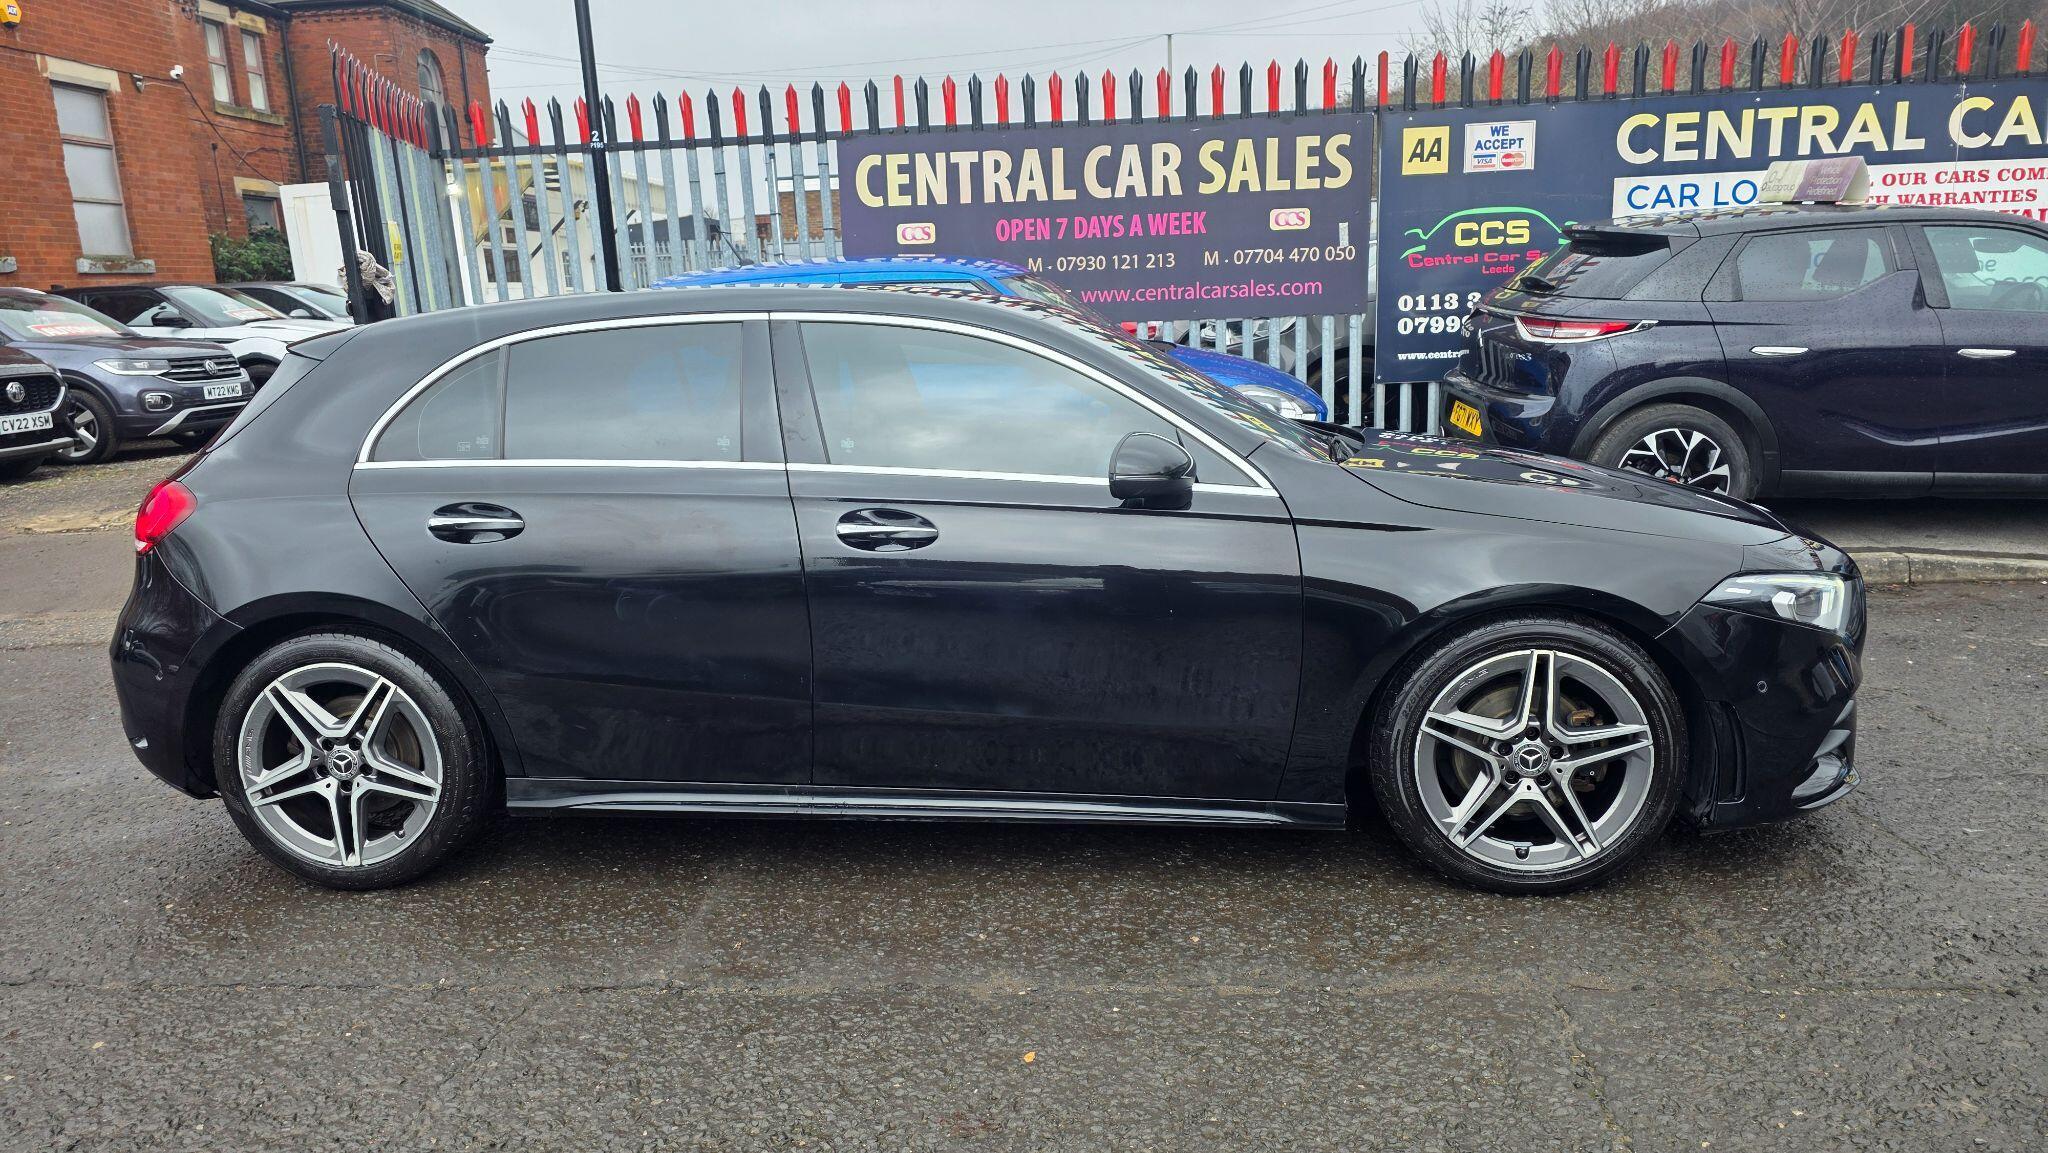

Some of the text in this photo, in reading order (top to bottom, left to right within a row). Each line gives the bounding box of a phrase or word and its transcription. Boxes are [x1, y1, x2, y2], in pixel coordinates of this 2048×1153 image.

[591, 130, 600, 142] 2
[1490, 125, 1510, 137] WE
[1616, 95, 2048, 165] CENTRAL CA
[1408, 137, 1442, 163] AA
[1474, 138, 1524, 151] ACCEPT
[855, 133, 1353, 208] CENTRAL CAR SALES
[1882, 172, 1928, 187] OUR
[1934, 169, 1990, 184] CARS
[1997, 166, 2048, 182] COM
[1627, 179, 1758, 210] CAR LO
[1897, 188, 2038, 205] WARRANTIES
[995, 211, 1207, 242] OPEN 7 DAYS A WEEK
[1274, 211, 1306, 227] CCS
[901, 225, 932, 242] CCS
[1454, 219, 1530, 247] CCS
[1028, 257, 1043, 273] M
[1056, 256, 1106, 272] 07930
[1112, 254, 1139, 270] 121
[1146, 252, 1176, 269] 213
[1204, 251, 1219, 266] M
[1233, 249, 1284, 265] 07704
[1289, 247, 1320, 263] 470
[1325, 246, 1356, 261] 050
[1408, 249, 1544, 268] Central Car S
[1482, 265, 1515, 274] Leeds
[1081, 279, 1323, 303] www.centralcarsales.com
[1397, 292, 1459, 312] 0113
[1397, 349, 1462, 361] www.centr
[1, 416, 51, 432] CV22 XSM
